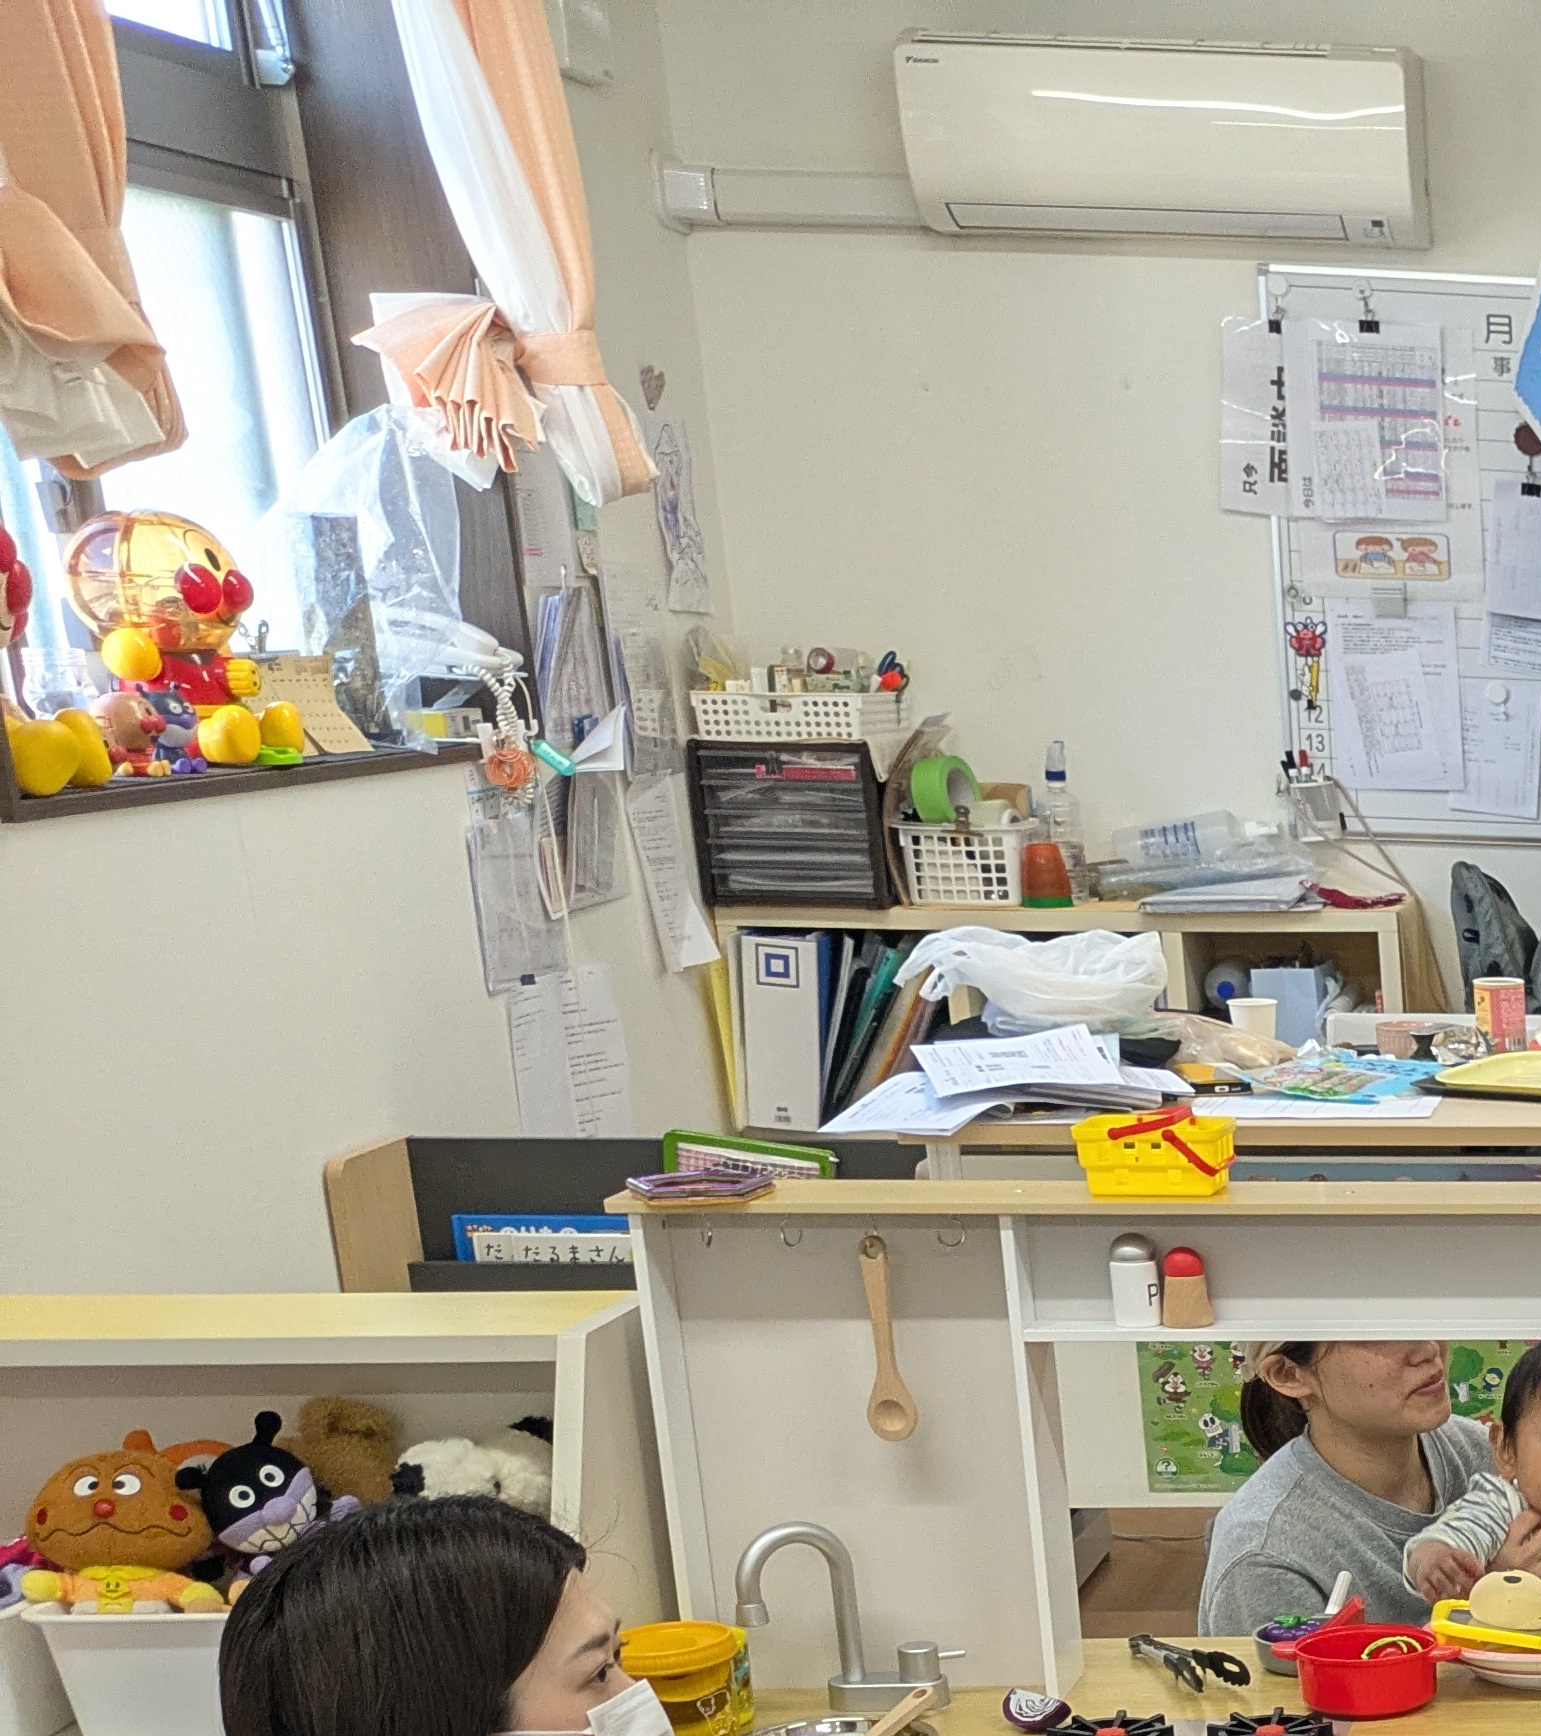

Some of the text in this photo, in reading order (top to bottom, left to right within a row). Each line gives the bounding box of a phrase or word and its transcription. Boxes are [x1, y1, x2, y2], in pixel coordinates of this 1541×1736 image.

[1484, 314, 1513, 344] 月
[1242, 463, 1258, 495] 只今
[1306, 734, 1326, 752] 13
[1147, 1283, 1159, 1306] P
